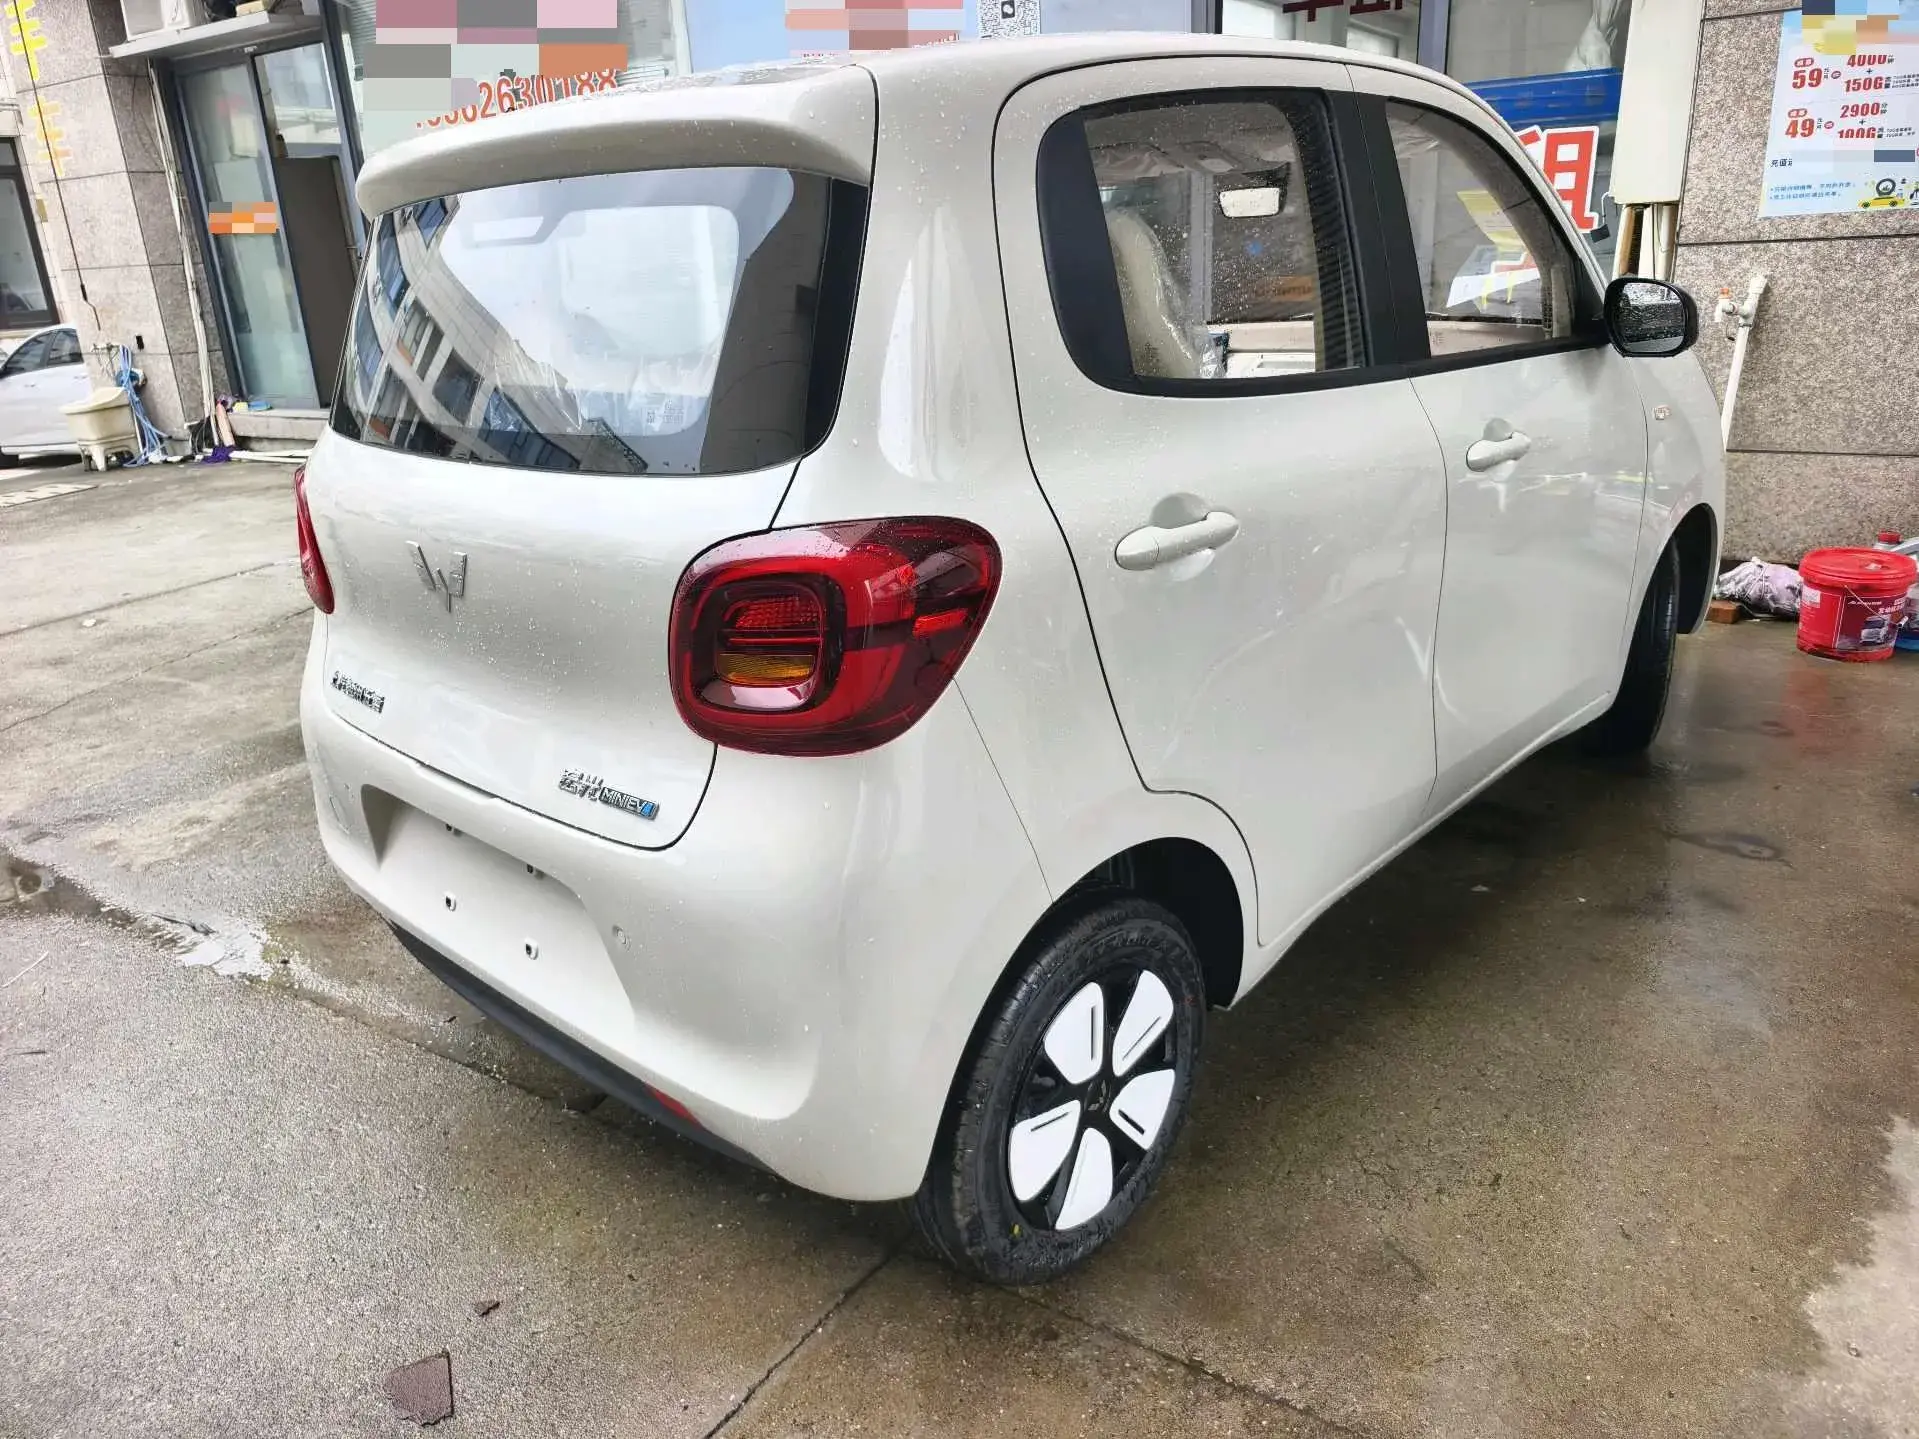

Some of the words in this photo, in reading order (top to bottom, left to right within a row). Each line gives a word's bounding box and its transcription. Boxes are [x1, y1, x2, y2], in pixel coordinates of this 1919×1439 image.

[1792, 68, 1822, 89] 59
[1845, 76, 1884, 92] 150G
[1840, 103, 1880, 118] 2900
[1785, 118, 1815, 138] 49
